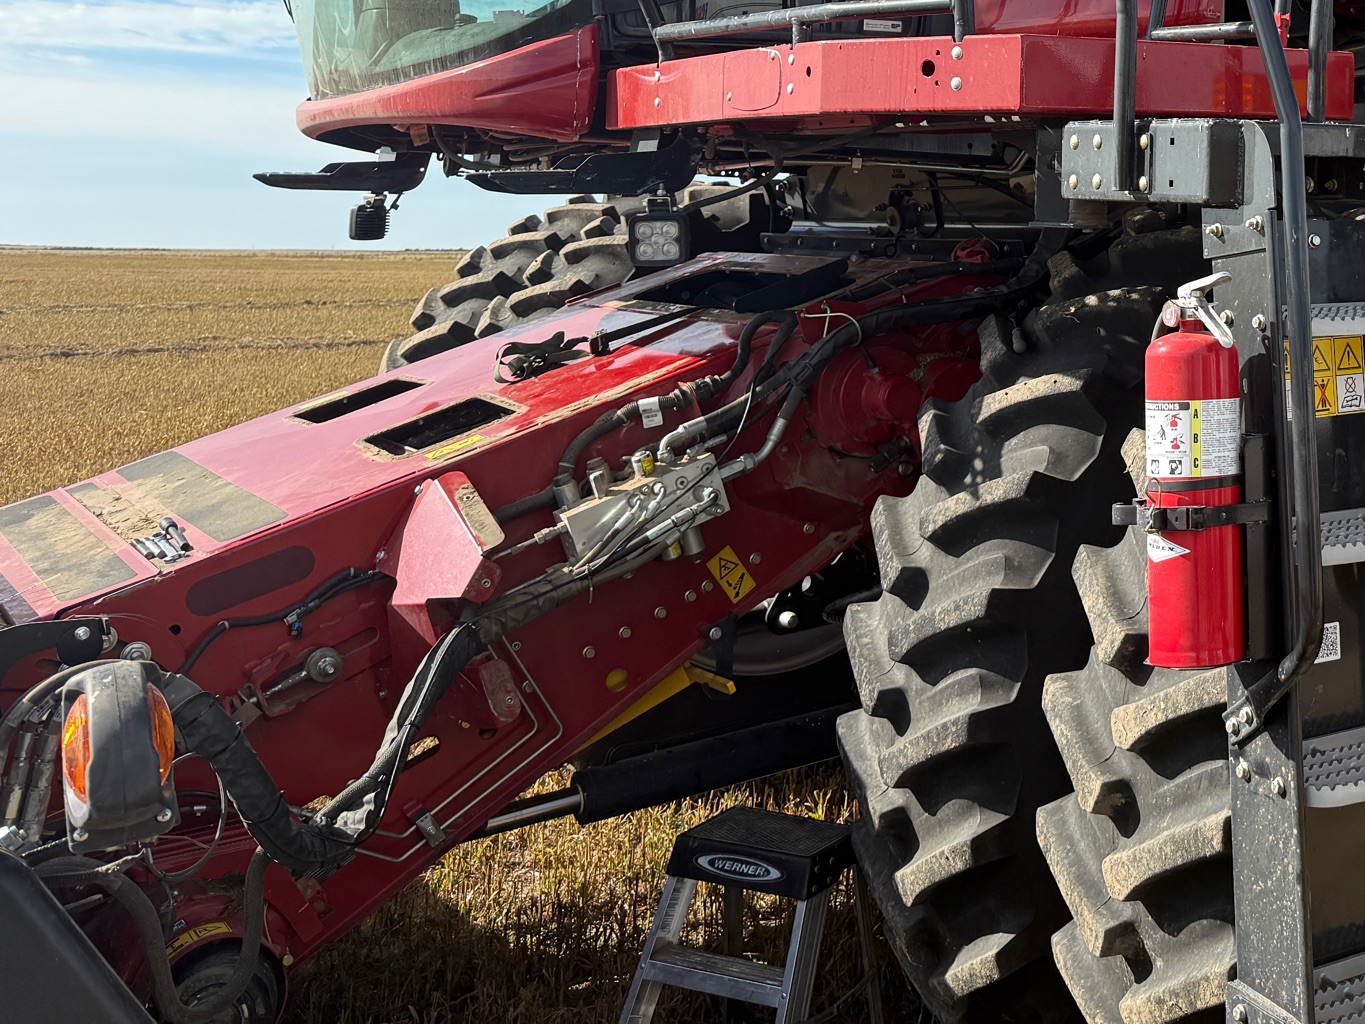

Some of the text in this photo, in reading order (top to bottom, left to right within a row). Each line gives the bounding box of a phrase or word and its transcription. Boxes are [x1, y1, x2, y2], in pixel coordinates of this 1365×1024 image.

[1193, 409, 1199, 468] A B C
[714, 859, 766, 876] WERNER
